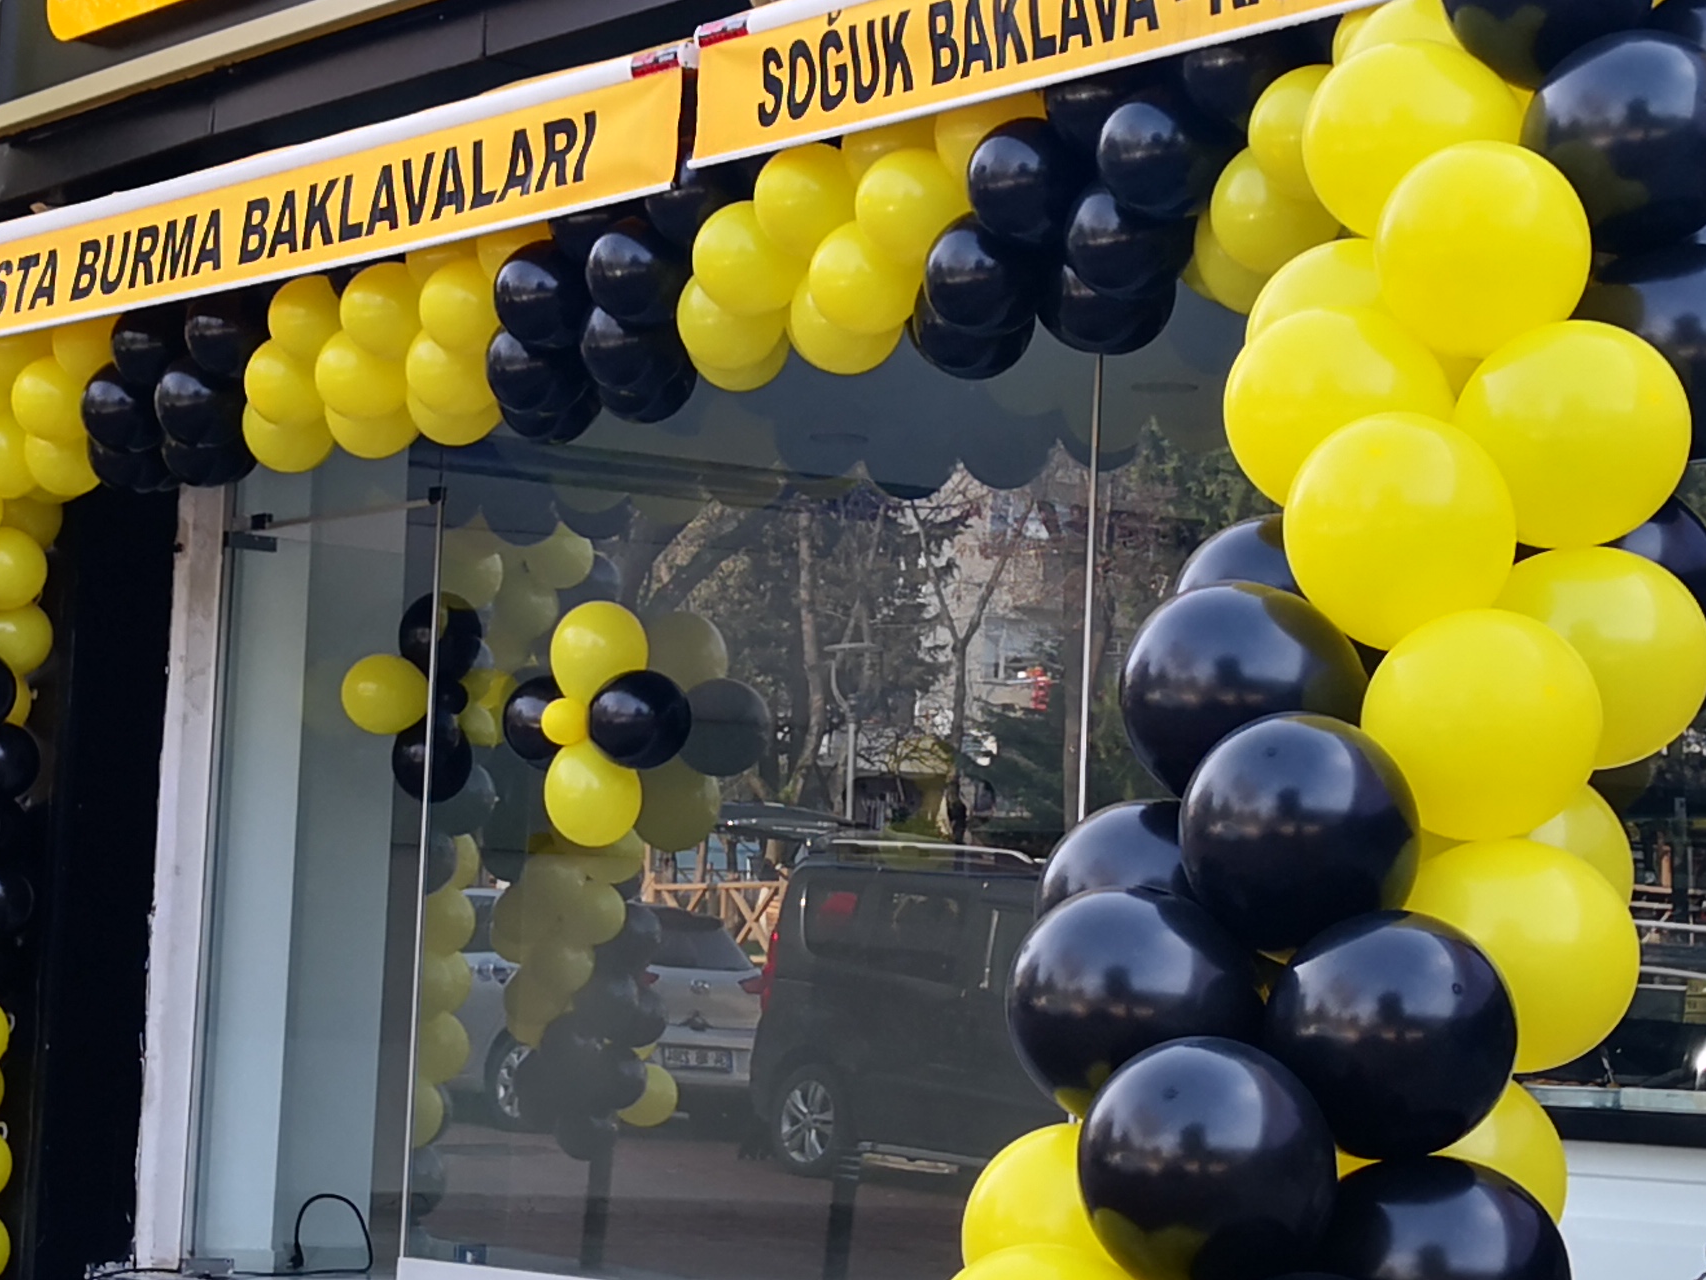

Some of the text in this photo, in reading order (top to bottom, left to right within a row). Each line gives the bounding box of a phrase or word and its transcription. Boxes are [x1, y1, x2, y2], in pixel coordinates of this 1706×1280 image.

[758, 8, 911, 129] SOĞUK
[70, 209, 223, 302] BURMA
[239, 111, 597, 267] BAKLAVALARI
